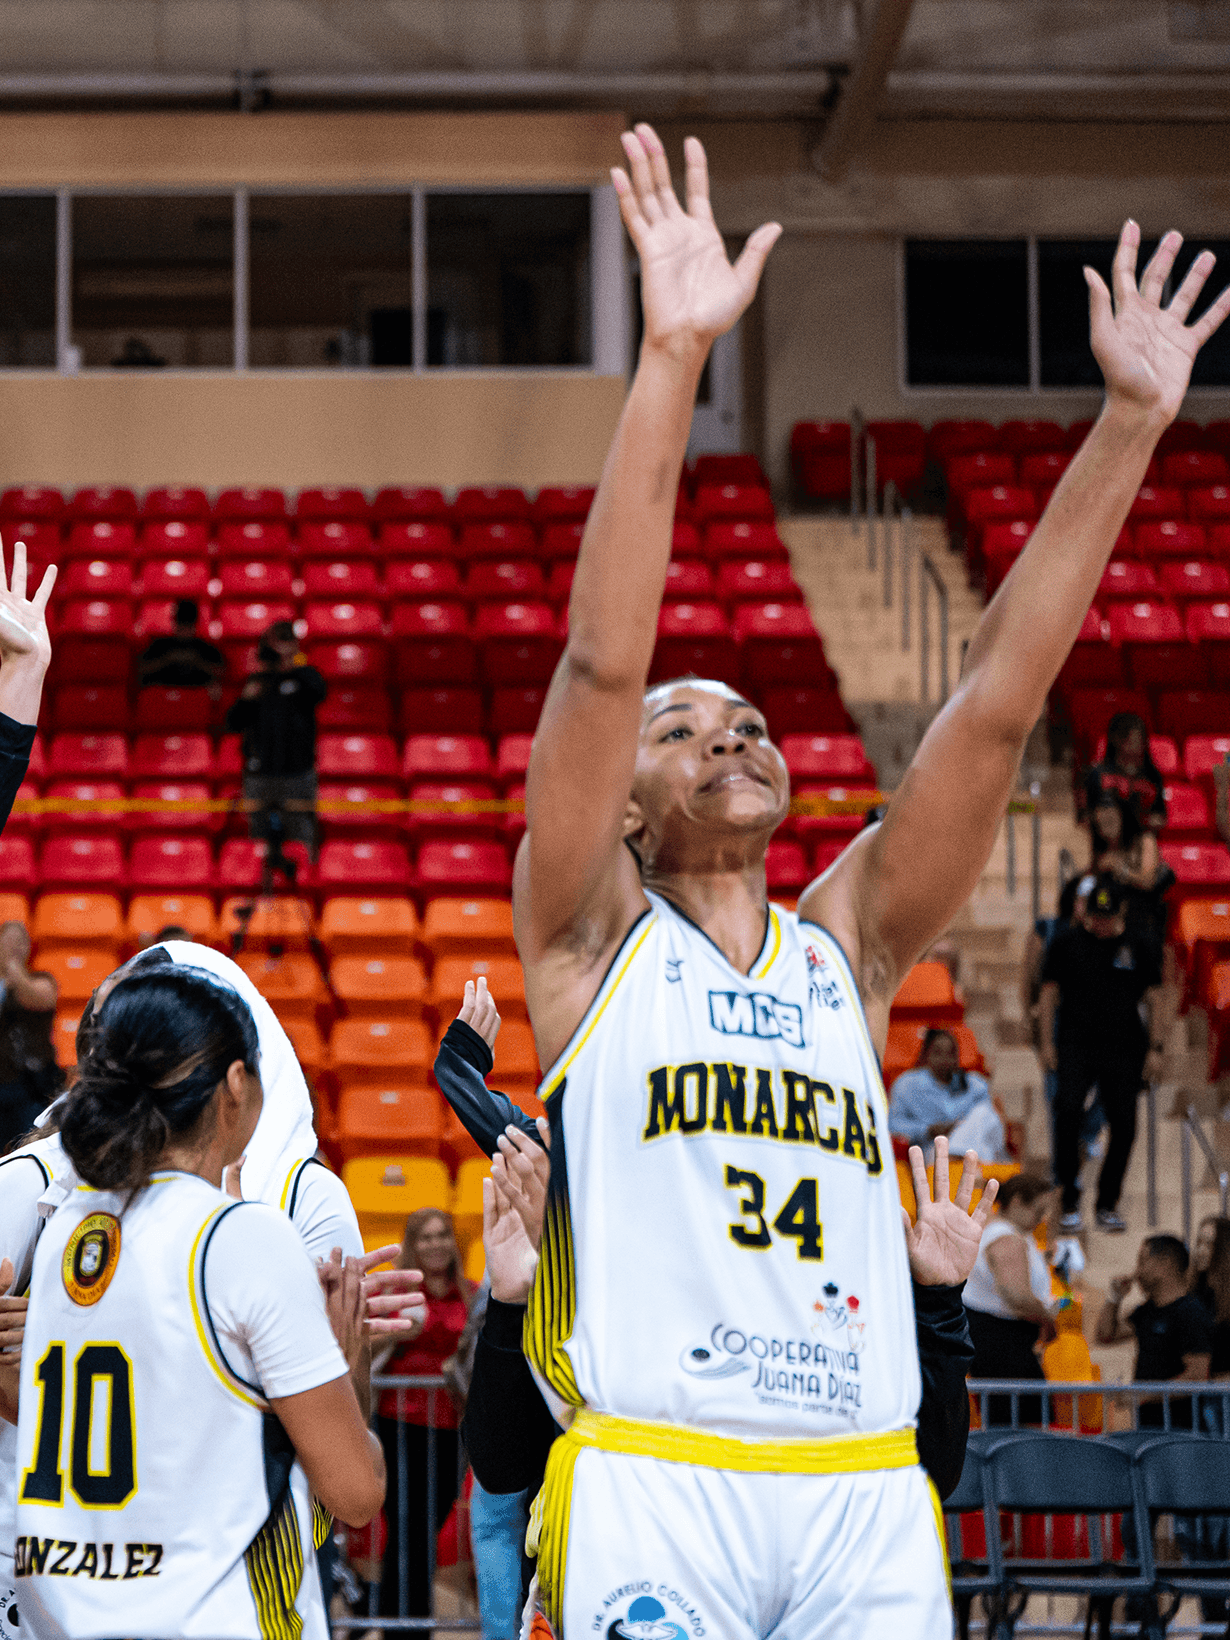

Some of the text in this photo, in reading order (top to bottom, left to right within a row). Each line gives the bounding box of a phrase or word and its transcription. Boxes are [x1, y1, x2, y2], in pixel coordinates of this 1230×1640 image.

[708, 990, 806, 1049] MCS
[723, 1163, 823, 1263] 34
[751, 1361, 821, 1399] JUANA
[17, 1340, 139, 1511] 10
[603, 1581, 652, 1609] AURELIO
